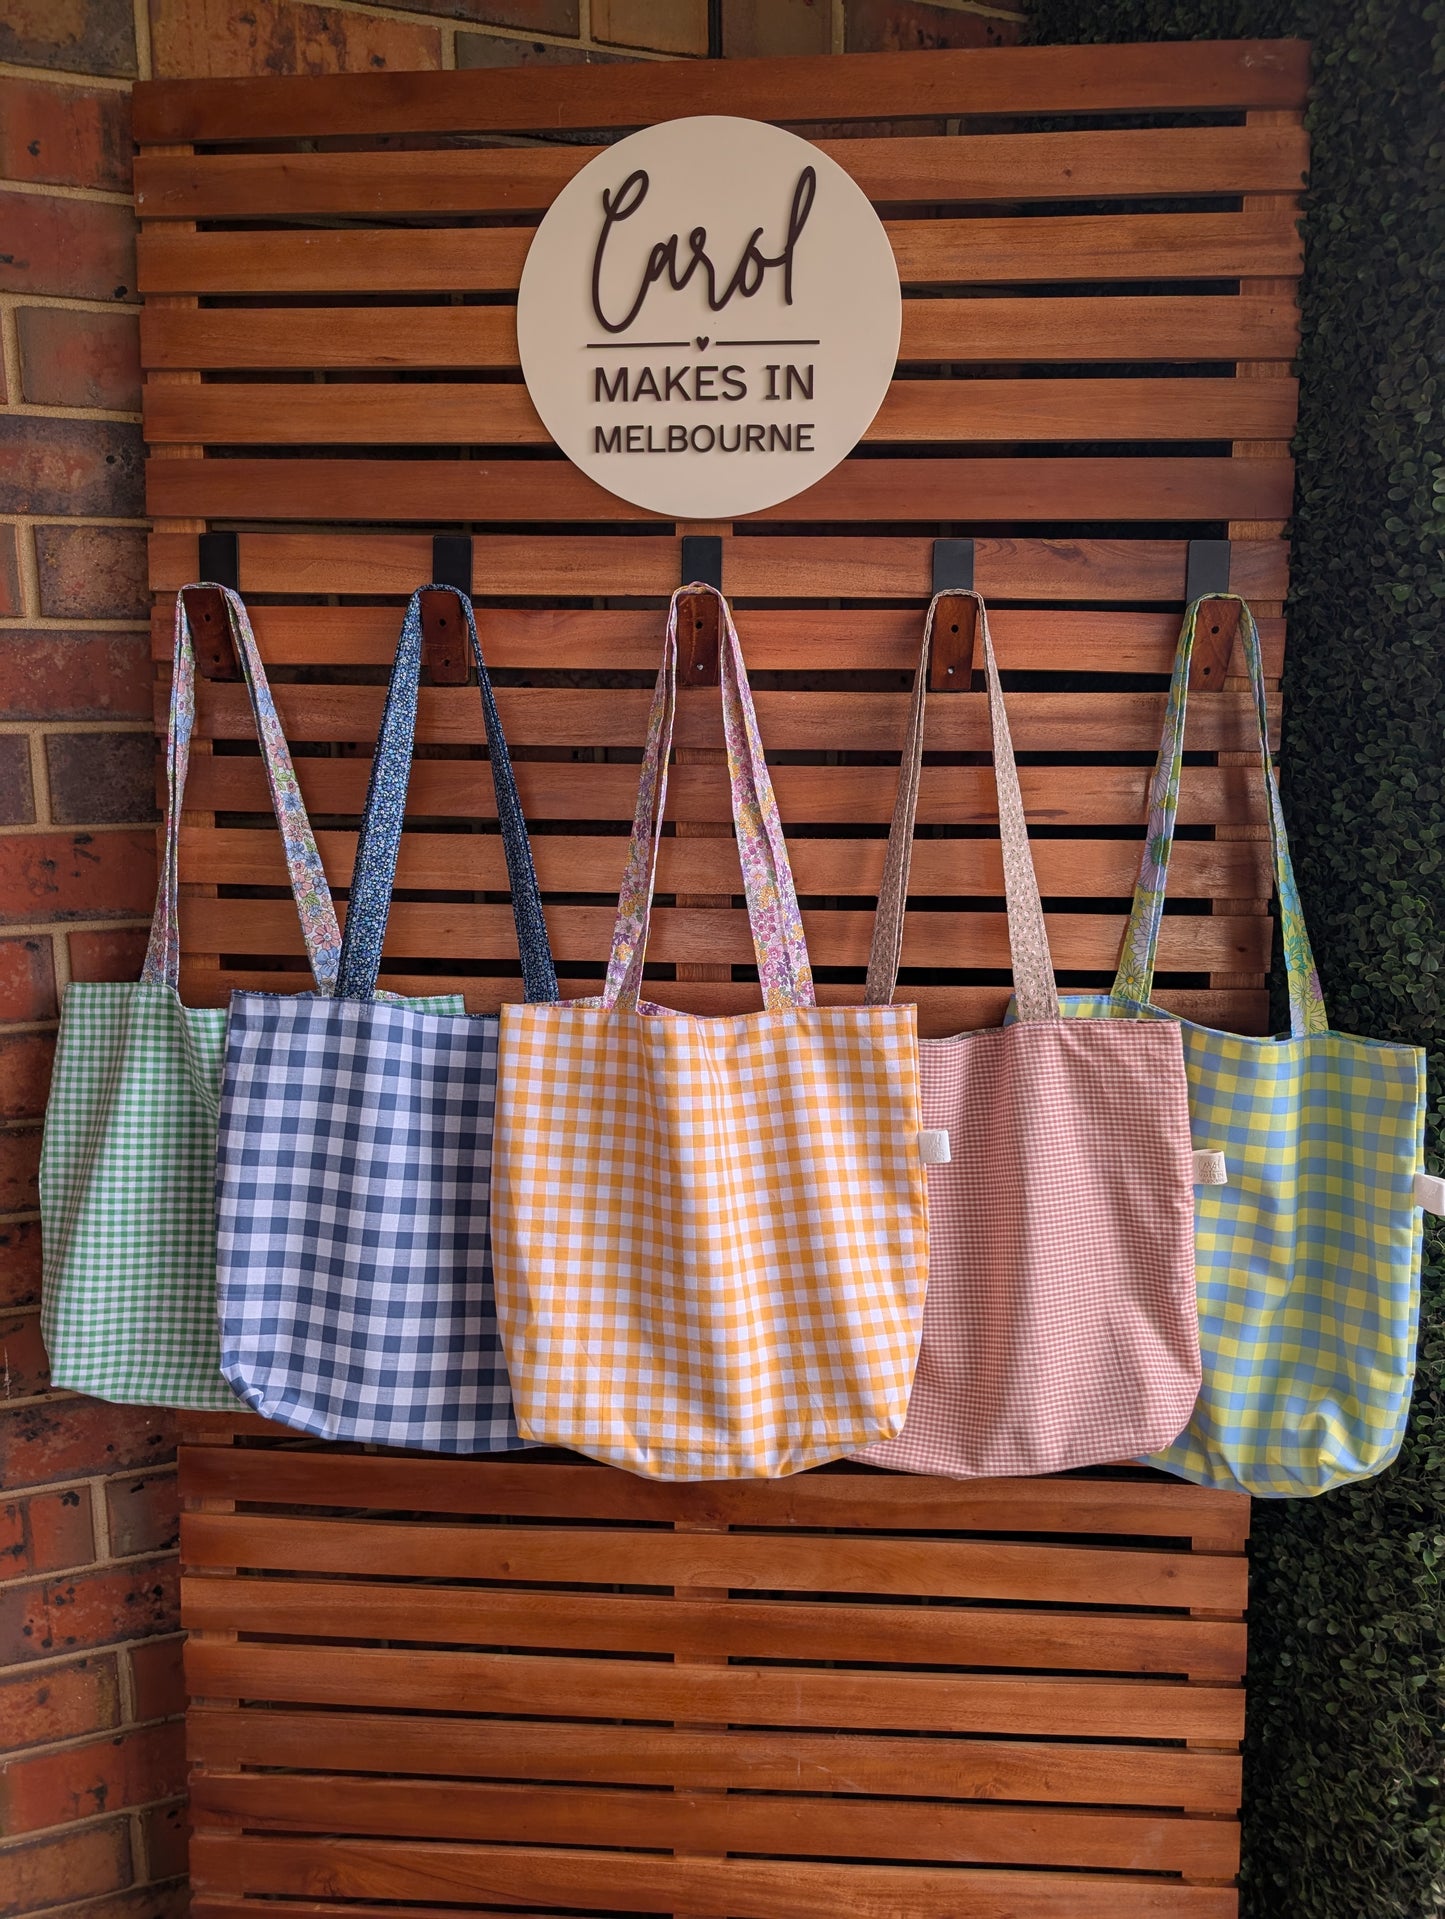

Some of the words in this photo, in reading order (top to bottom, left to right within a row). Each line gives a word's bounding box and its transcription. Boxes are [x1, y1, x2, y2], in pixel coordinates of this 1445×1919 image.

[591, 165, 817, 334] Carol
[594, 365, 748, 403] MAKES
[764, 364, 814, 401] IN
[594, 423, 815, 454] MELBOURNE
